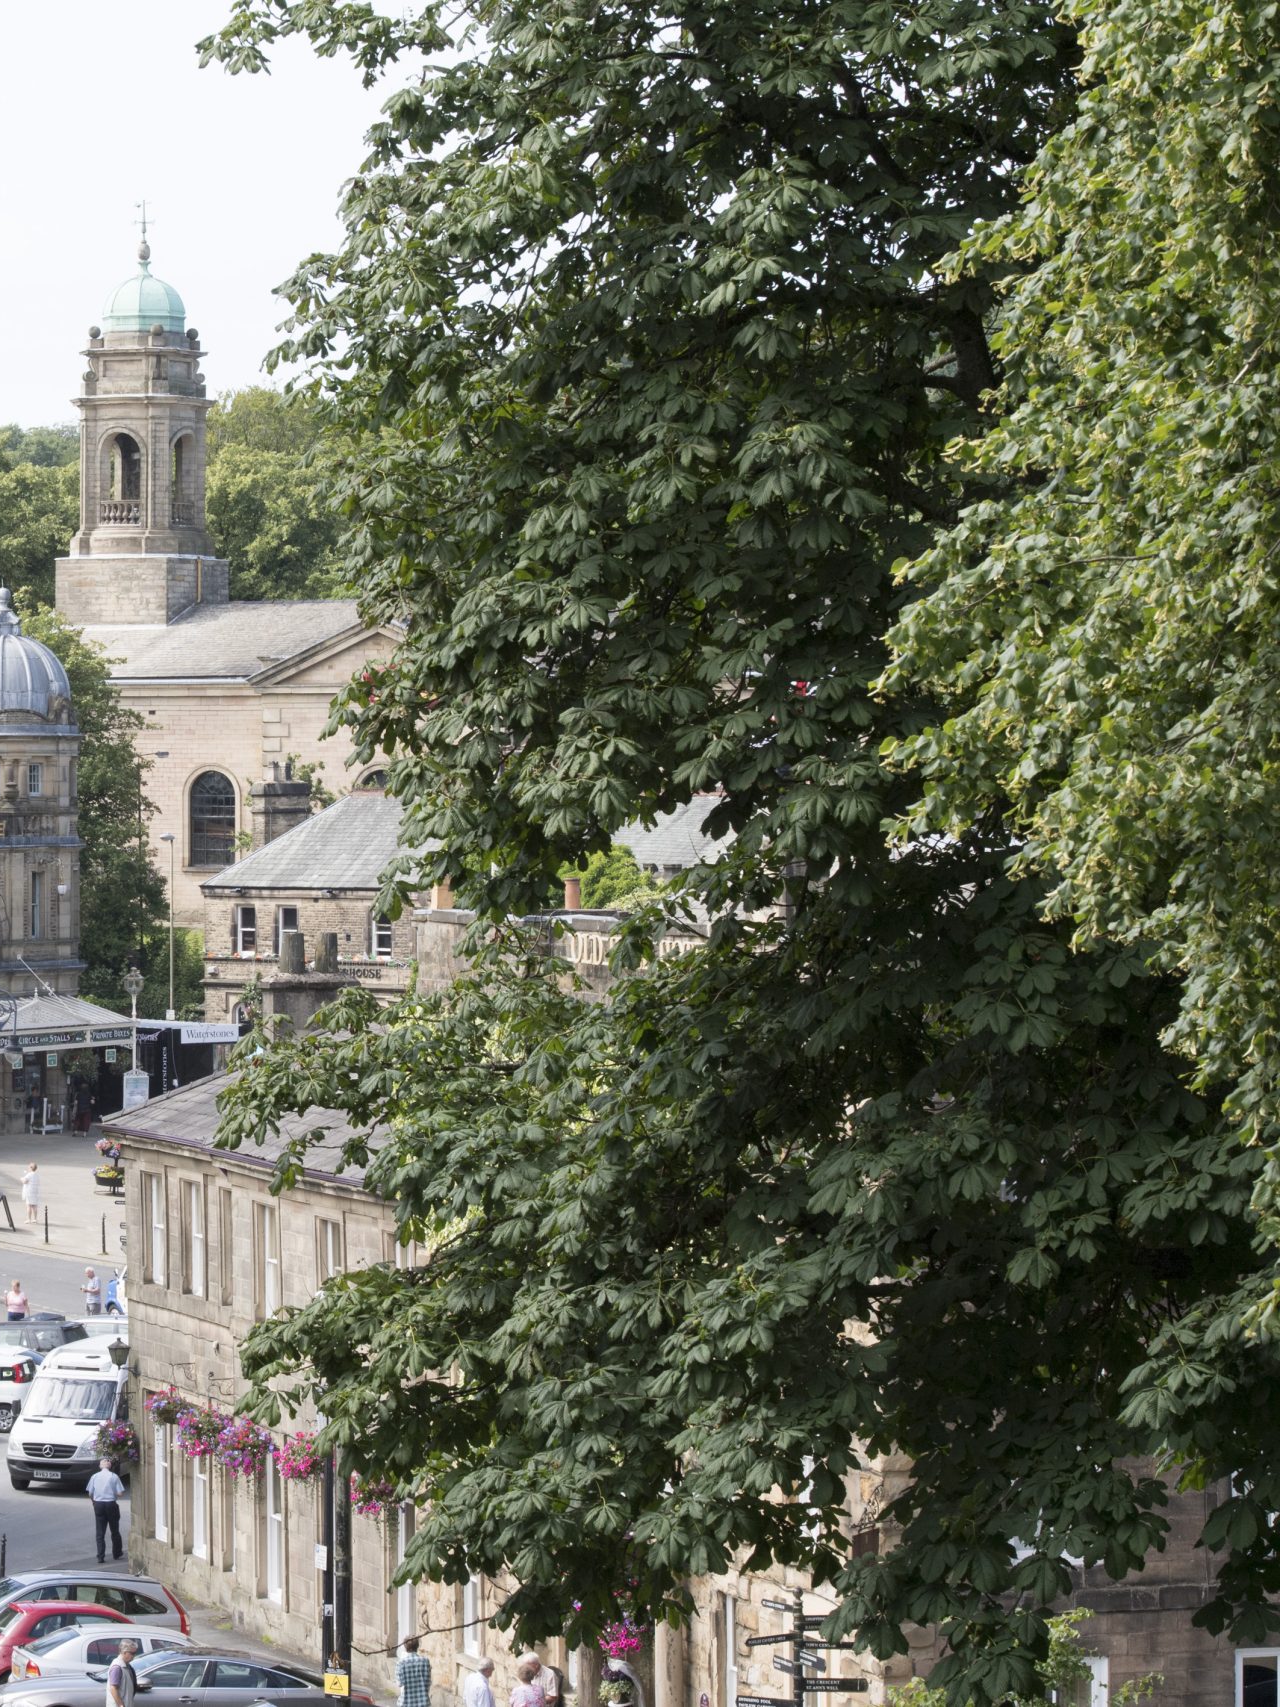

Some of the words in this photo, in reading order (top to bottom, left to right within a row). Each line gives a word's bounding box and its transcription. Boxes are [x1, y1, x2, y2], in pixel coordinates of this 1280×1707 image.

[18, 1036, 39, 1045] CIRCLE
[49, 1034, 71, 1043] STALLS
[91, 1031, 112, 1039] PRIVATE
[113, 1030, 131, 1038] BOXES
[185, 1029, 234, 1040] Waterstones
